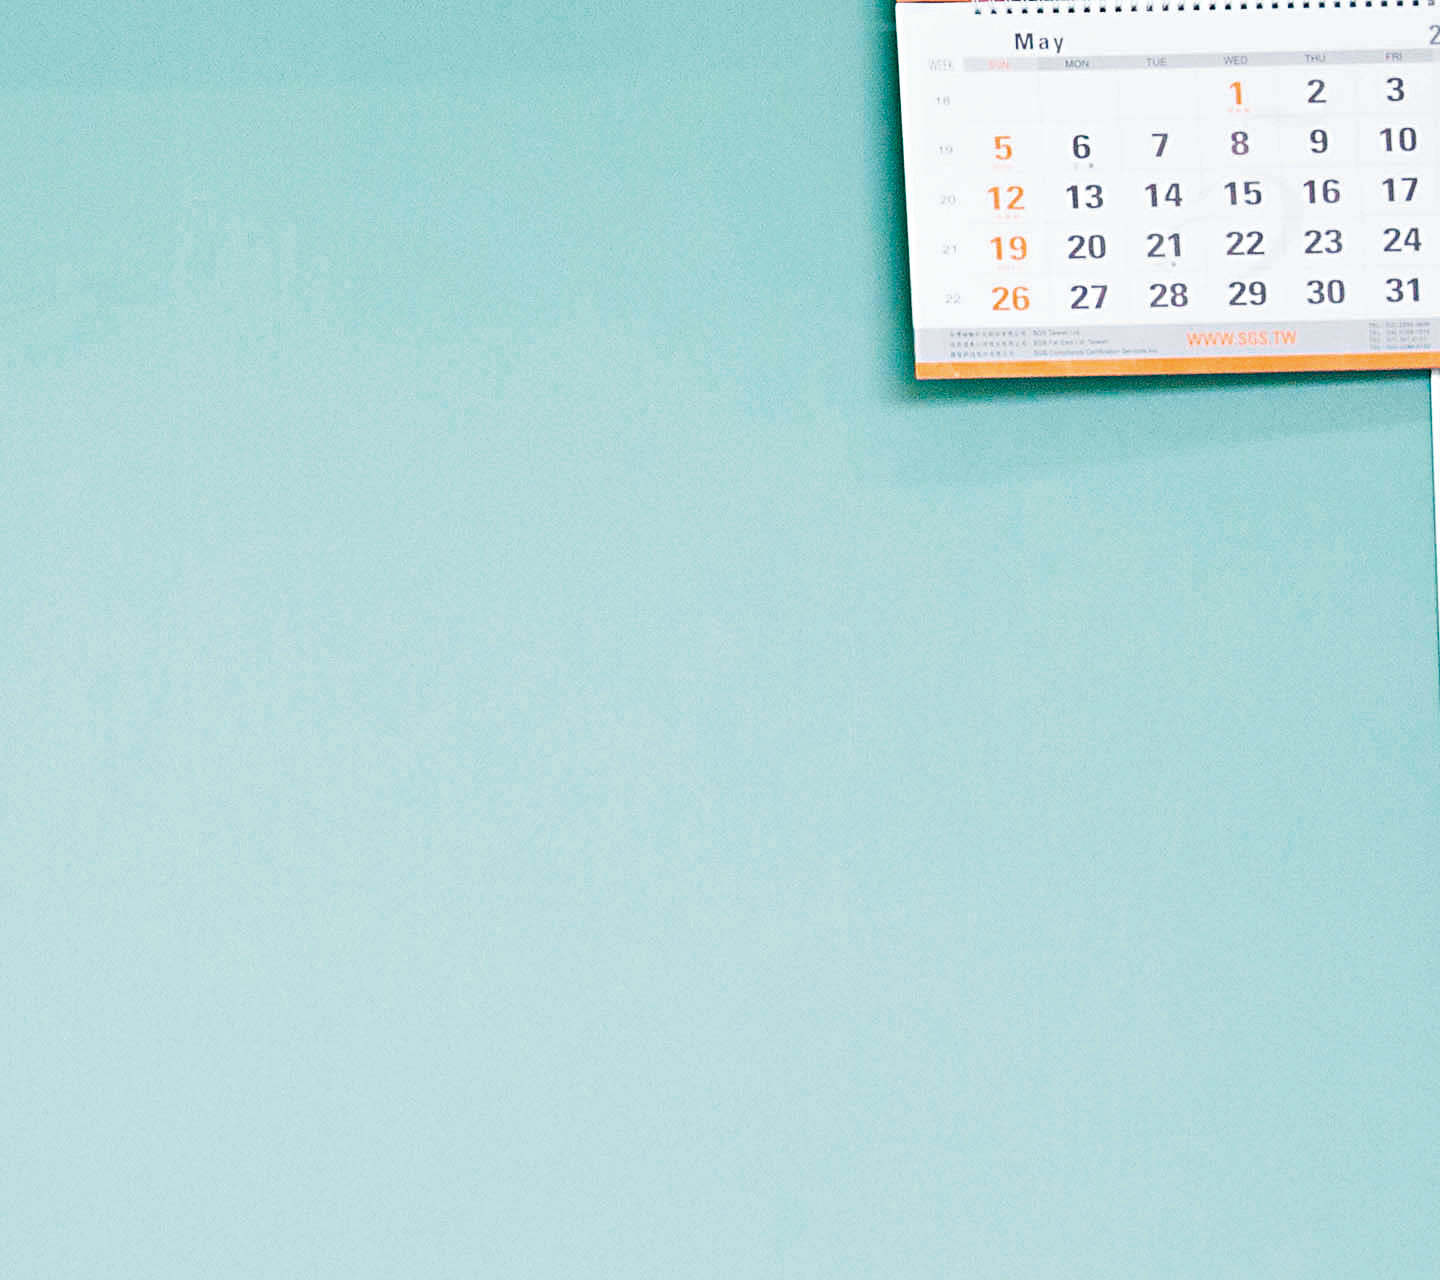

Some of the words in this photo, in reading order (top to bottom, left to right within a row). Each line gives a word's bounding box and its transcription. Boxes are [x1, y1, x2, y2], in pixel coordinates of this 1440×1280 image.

[1015, 33, 1063, 53] May
[1230, 82, 1242, 104] 1
[1308, 79, 1326, 103] 2
[1387, 77, 1404, 101] 3
[1187, 329, 1297, 348] WWW.SGS.TW
